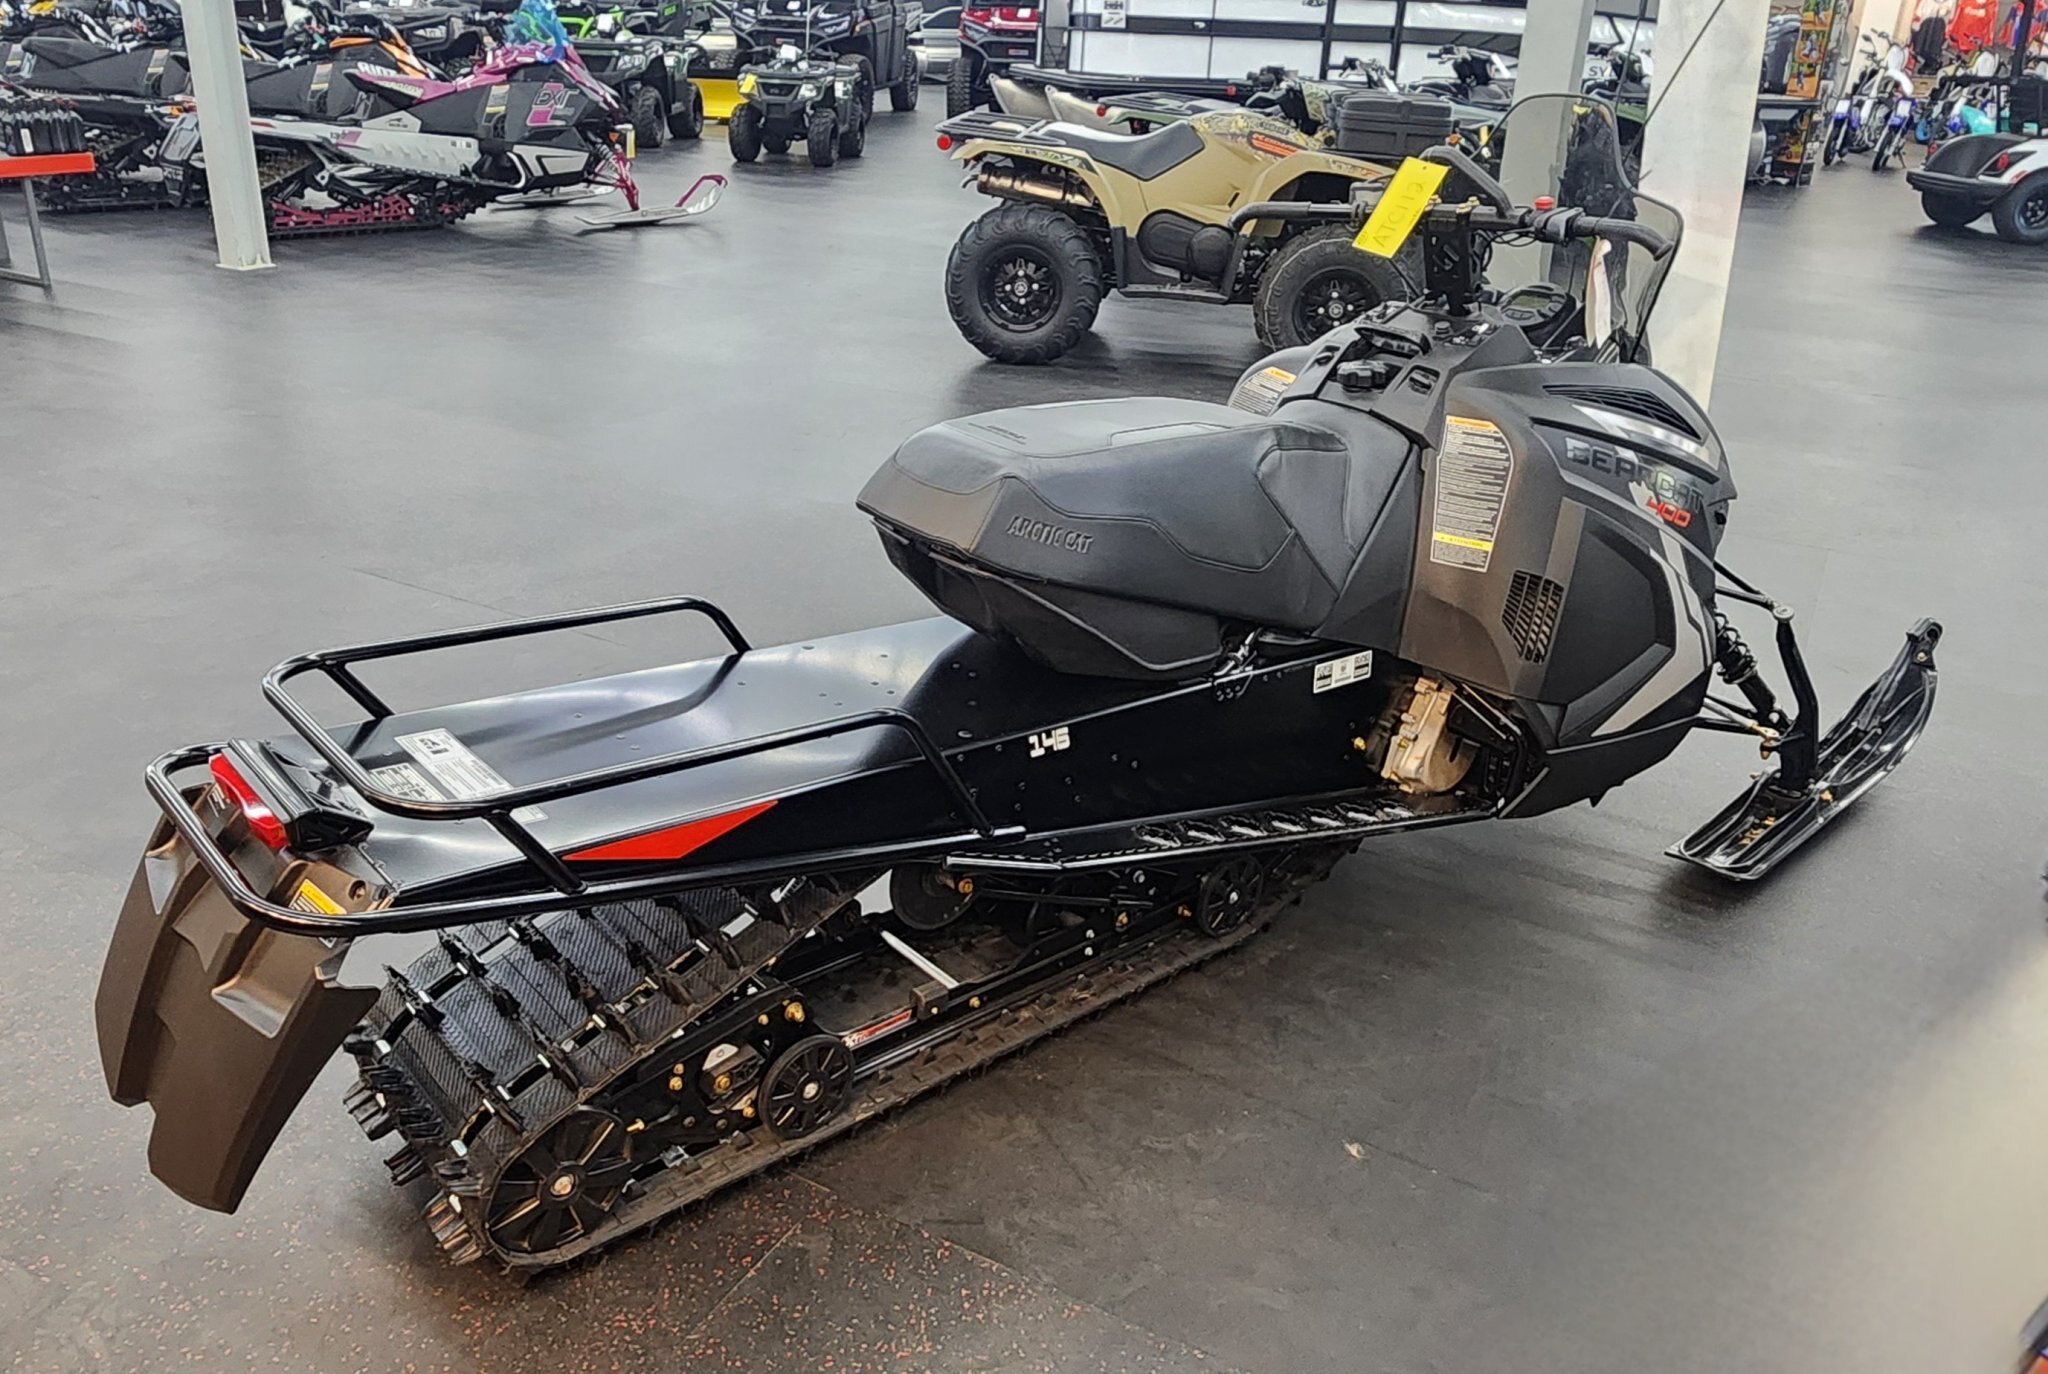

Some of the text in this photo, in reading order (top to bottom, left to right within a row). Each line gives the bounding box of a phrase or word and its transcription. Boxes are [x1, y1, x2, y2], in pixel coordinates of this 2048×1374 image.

[1564, 437, 1703, 513] BEARCAT
[1646, 495, 1692, 528] 400
[1006, 514, 1095, 554] ARCTIC CAT
[1028, 726, 1071, 758] 146
